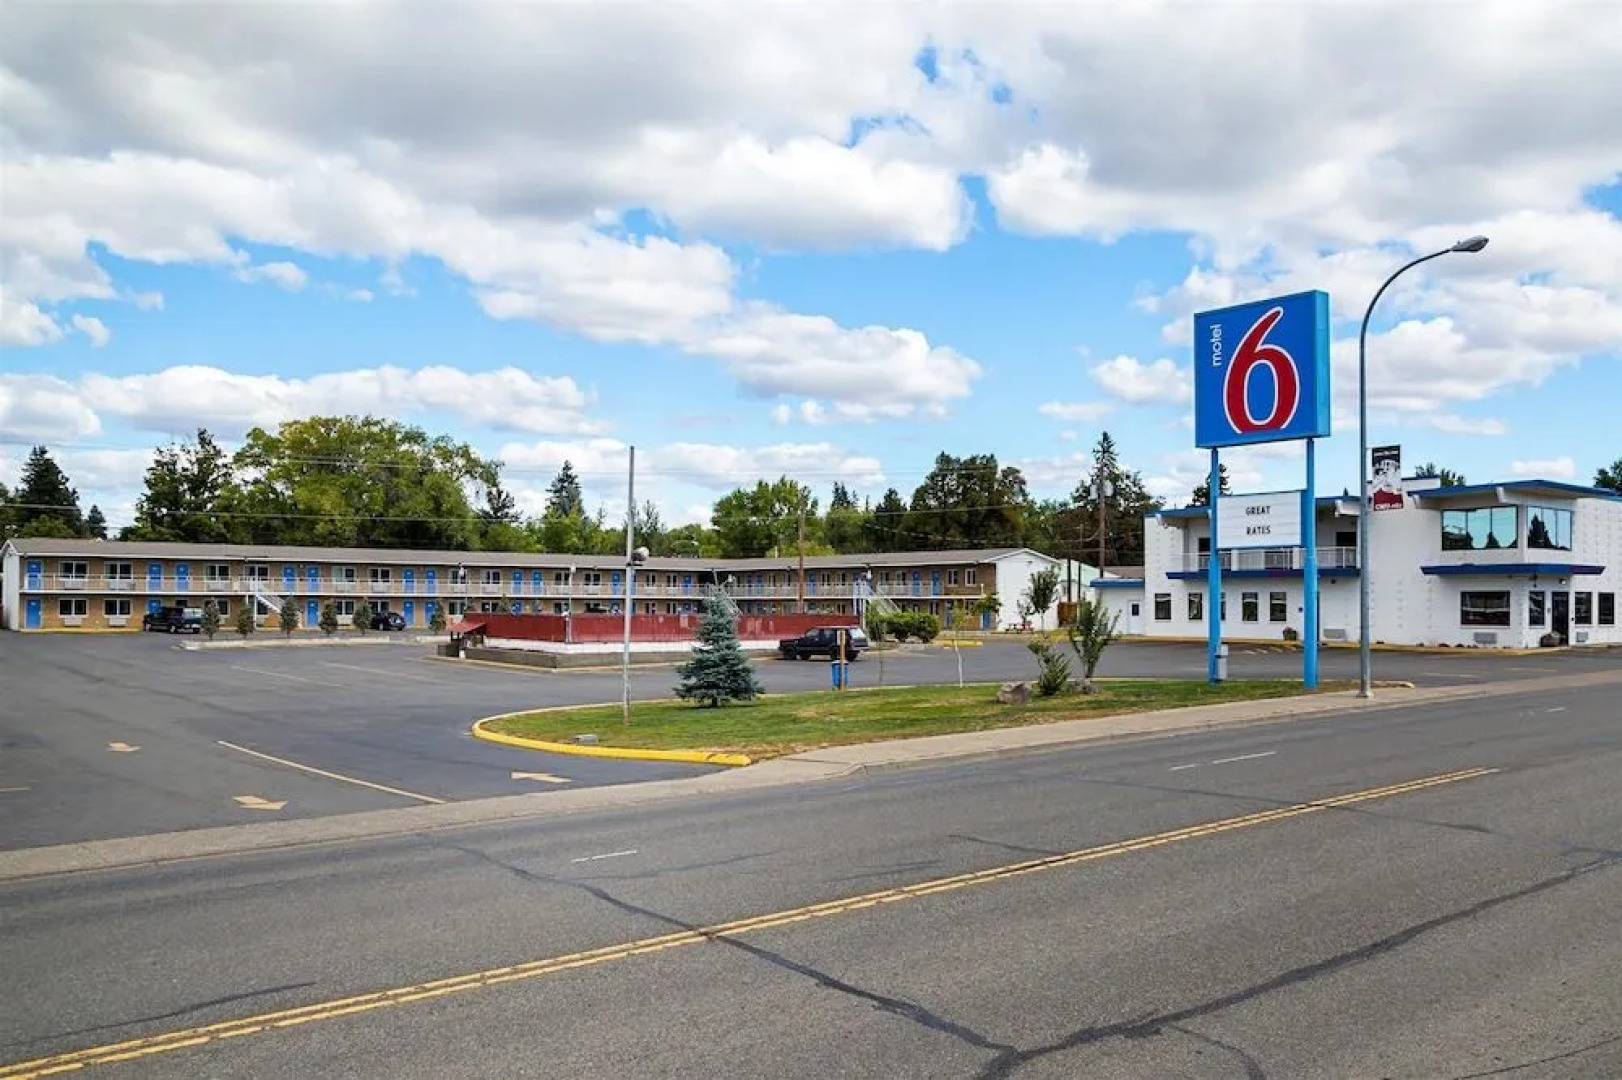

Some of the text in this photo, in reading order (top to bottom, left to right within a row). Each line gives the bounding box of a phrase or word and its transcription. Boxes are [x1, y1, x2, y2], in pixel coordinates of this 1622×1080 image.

[1210, 306, 1300, 434] motel 6
[1245, 505, 1271, 516] GREAT
[1246, 525, 1271, 536] RATES
